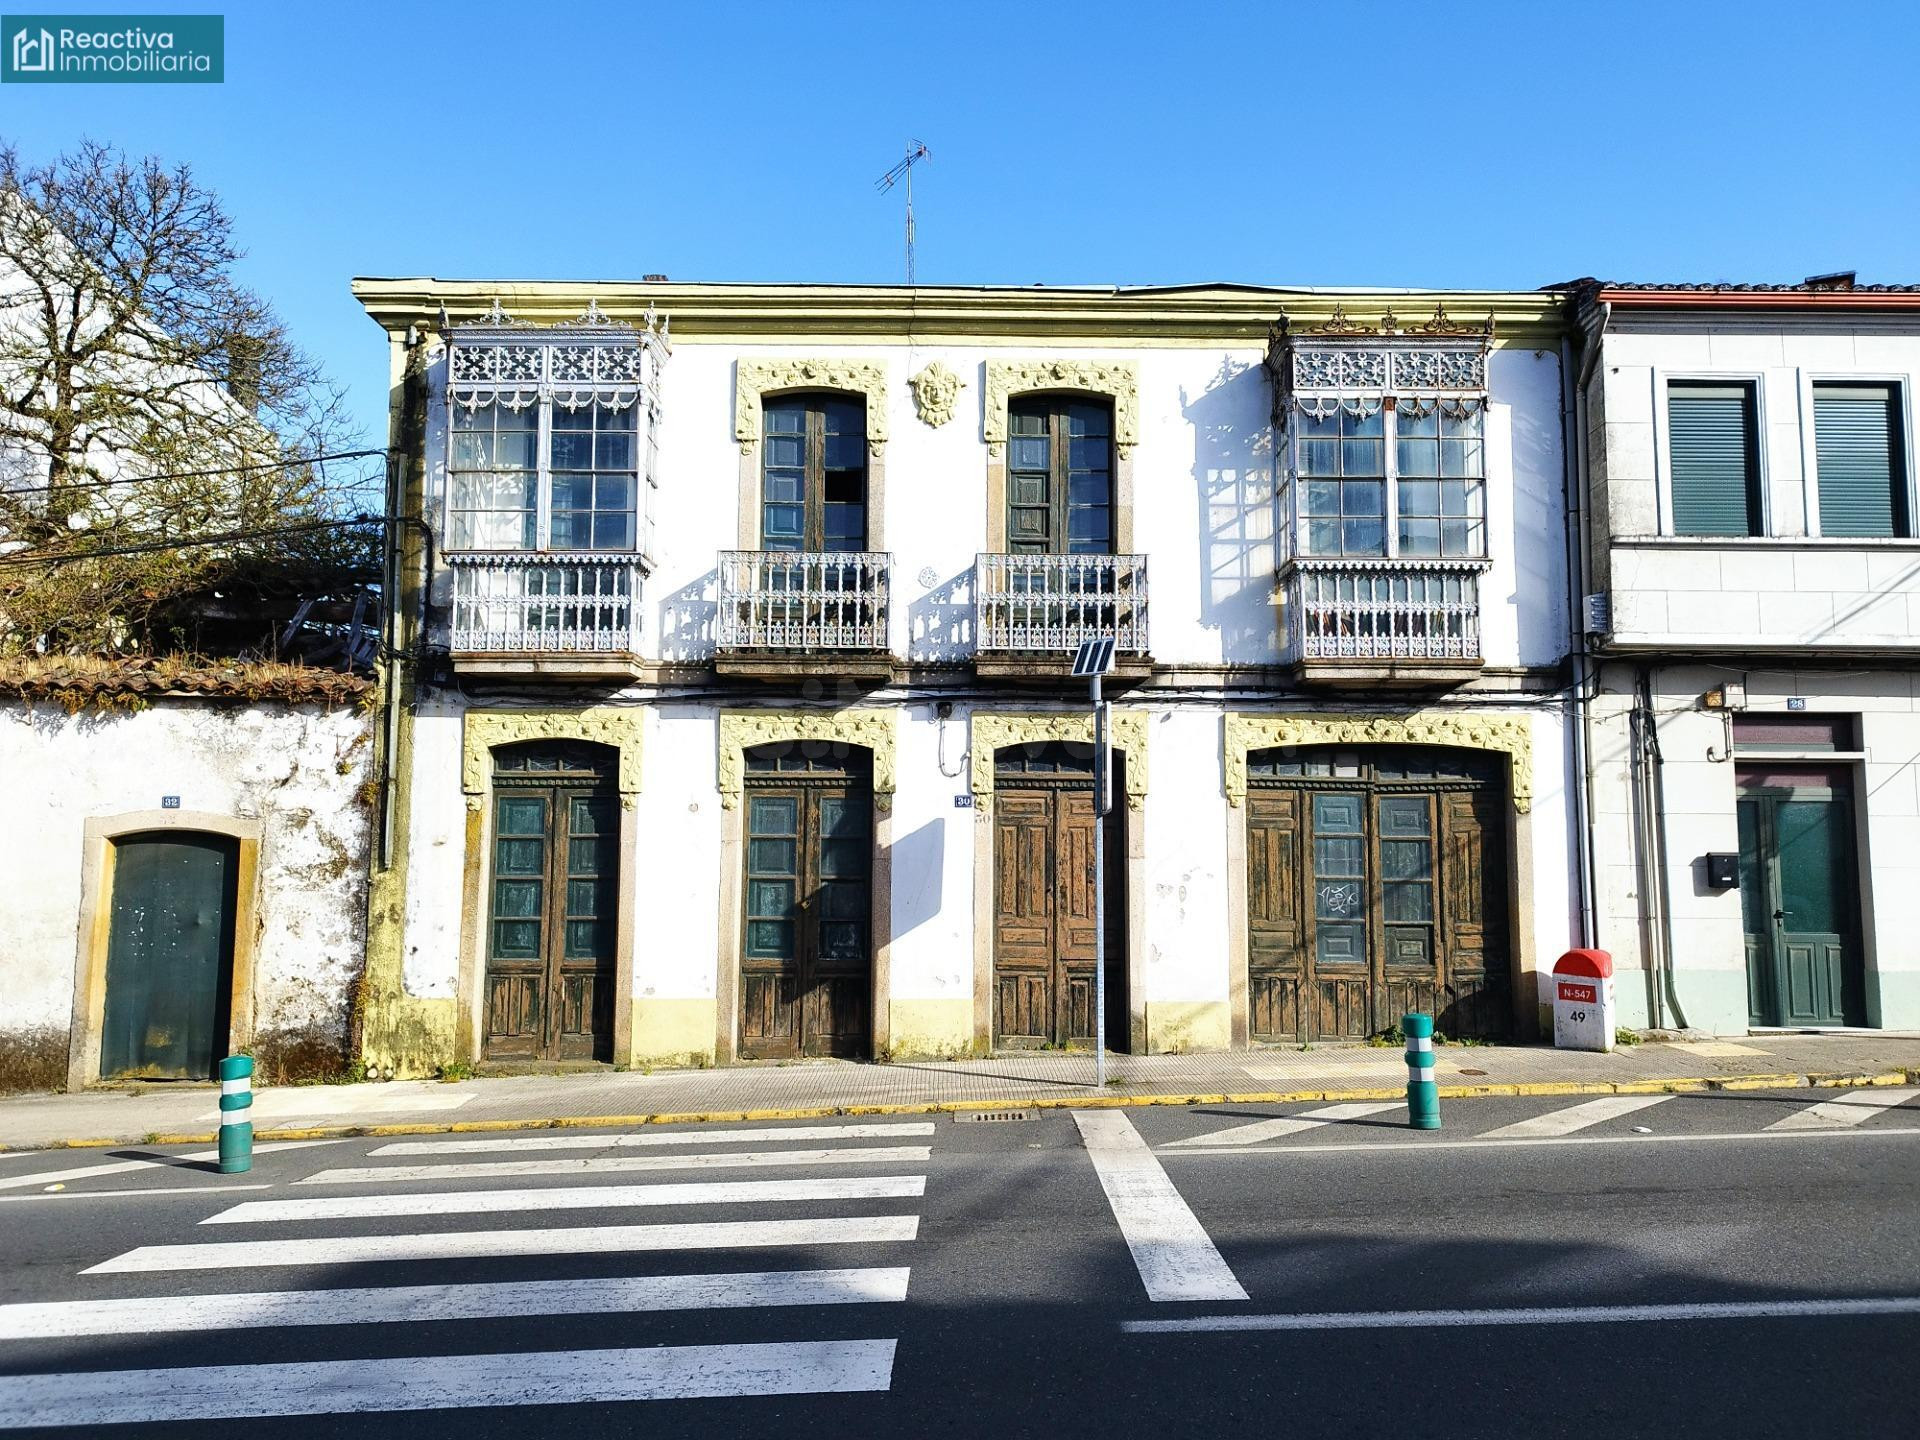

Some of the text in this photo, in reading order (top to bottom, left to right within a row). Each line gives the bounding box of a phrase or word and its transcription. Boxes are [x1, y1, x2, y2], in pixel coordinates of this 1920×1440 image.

[1791, 699, 1804, 708] 28
[165, 798, 177, 806] 32
[957, 797, 970, 806] 30
[1564, 988, 1591, 999] N-547
[1570, 1011, 1586, 1023] 49
